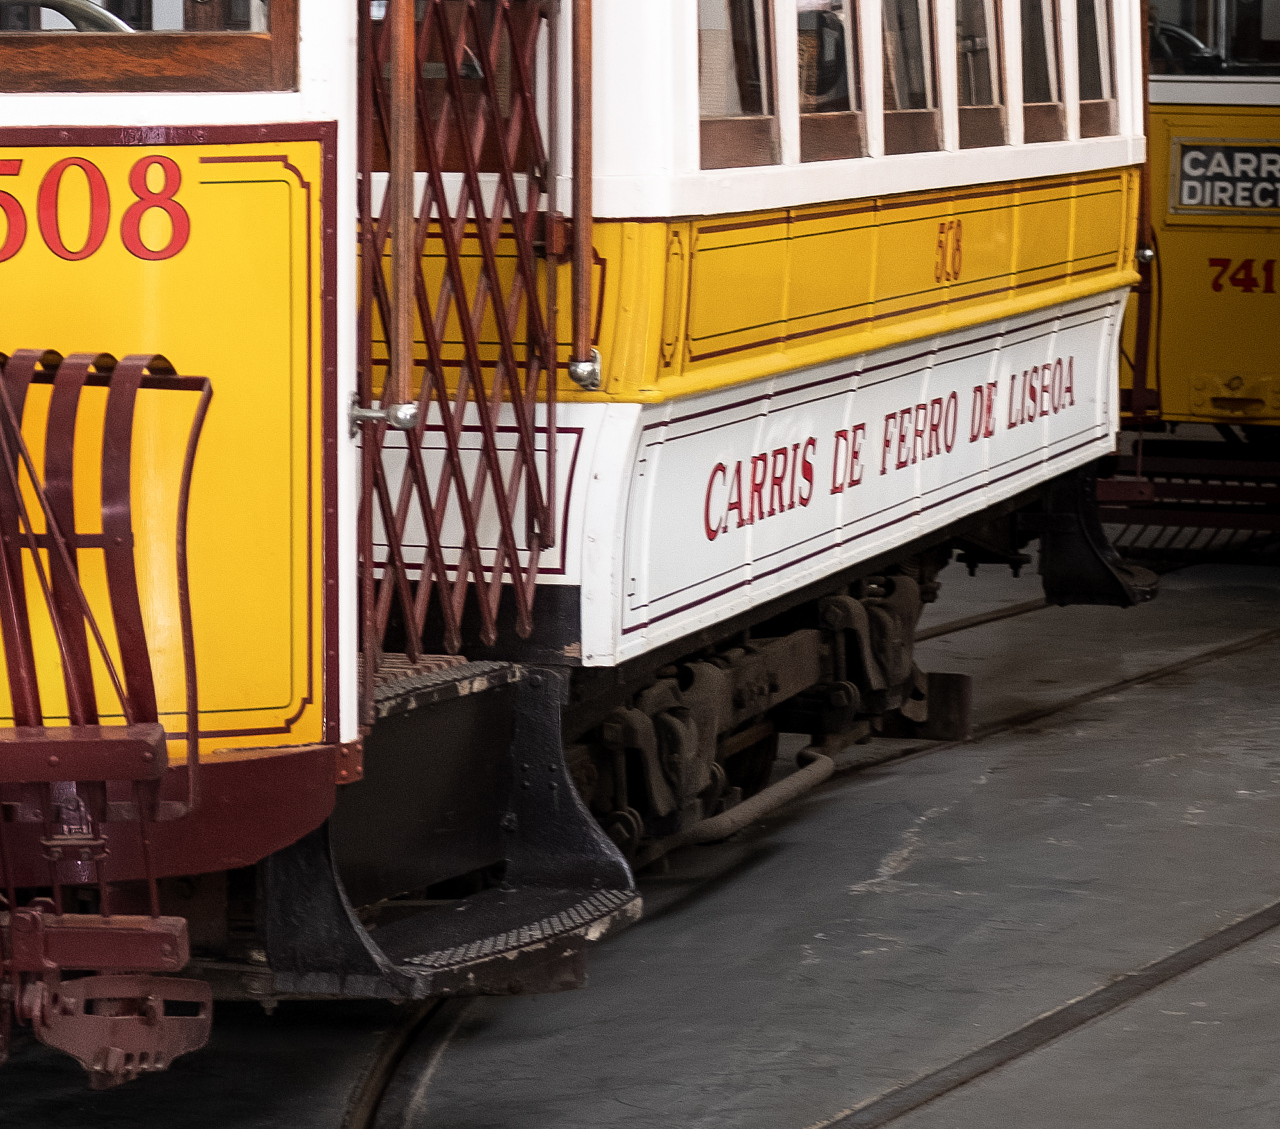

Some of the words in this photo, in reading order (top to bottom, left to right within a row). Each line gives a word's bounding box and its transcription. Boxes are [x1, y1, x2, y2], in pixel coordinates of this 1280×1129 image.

[1181, 180, 1280, 207] DIREC
[1209, 258, 1277, 293] 741
[704, 436, 817, 541] CARRIS
[830, 423, 866, 495] DE
[880, 391, 958, 475] FERRO
[969, 381, 998, 442] DE
